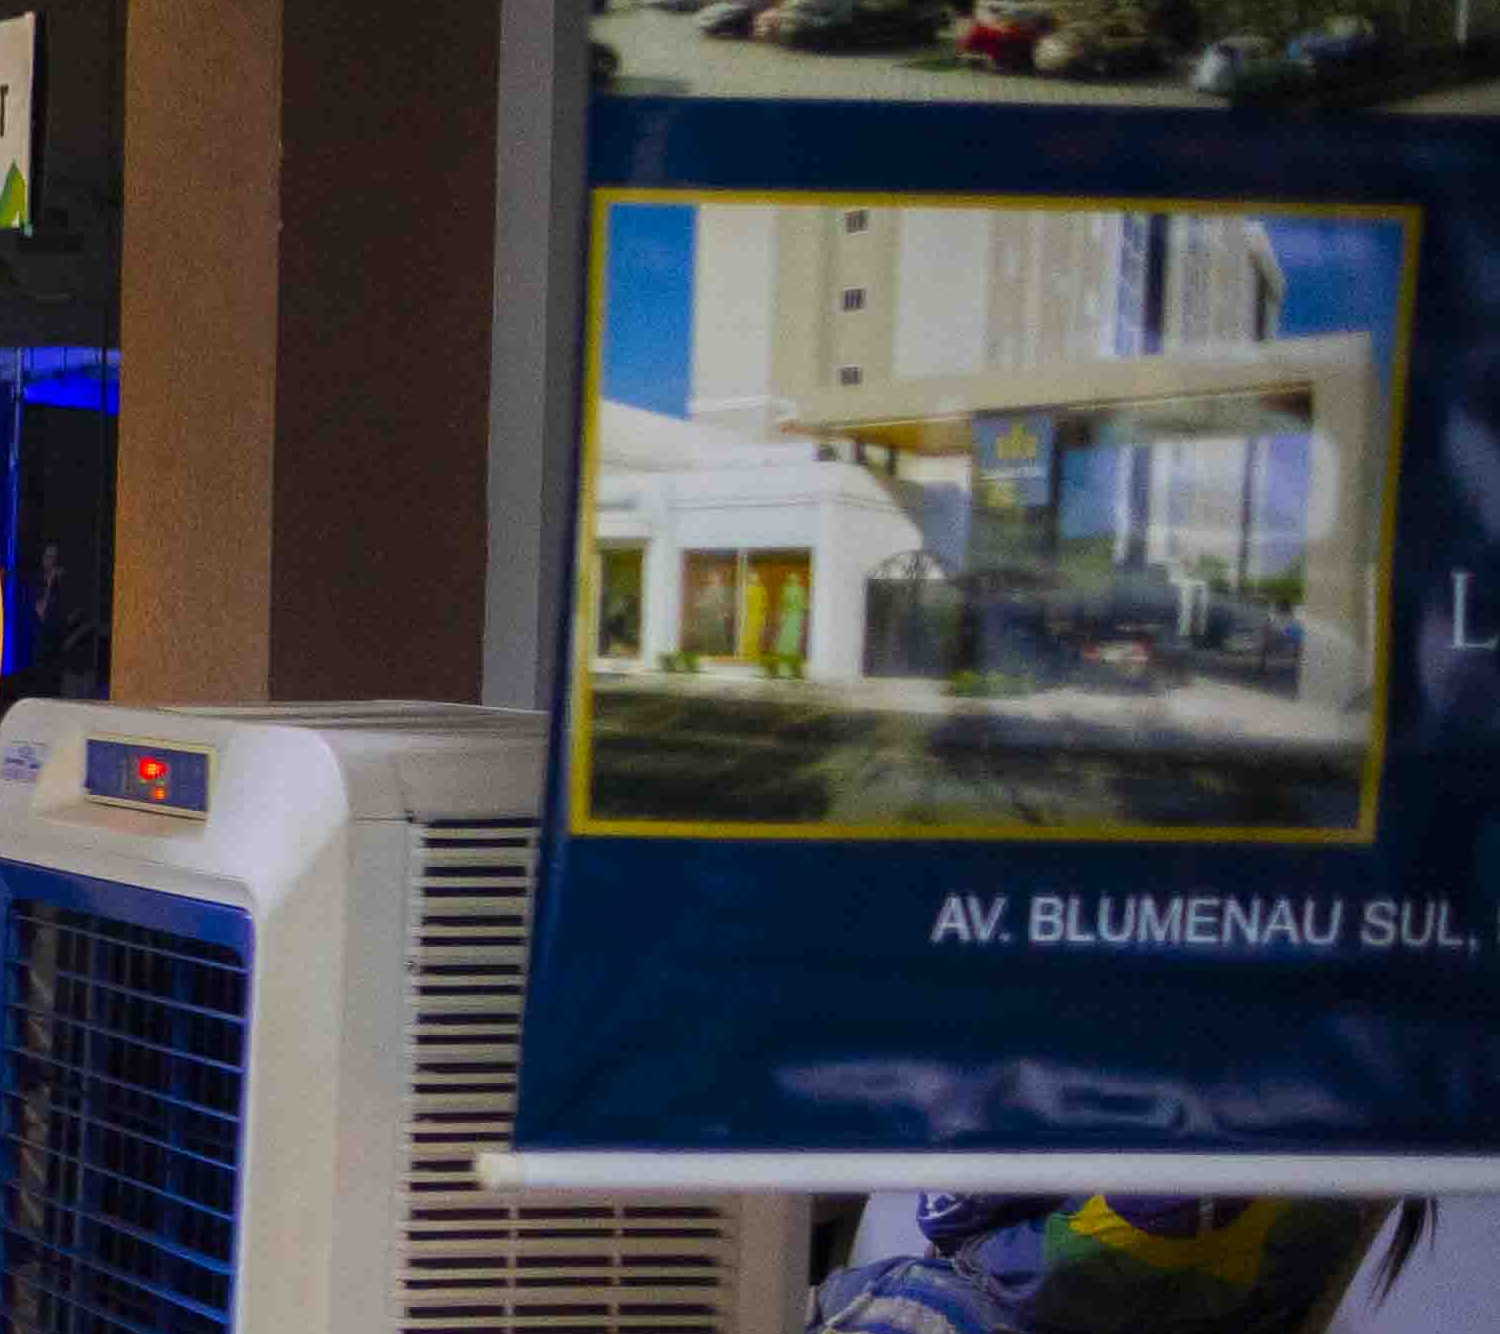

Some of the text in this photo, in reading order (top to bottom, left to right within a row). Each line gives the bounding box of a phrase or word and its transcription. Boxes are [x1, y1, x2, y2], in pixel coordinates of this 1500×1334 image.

[931, 893, 1480, 956] AV. BLUMENAU SUL,
